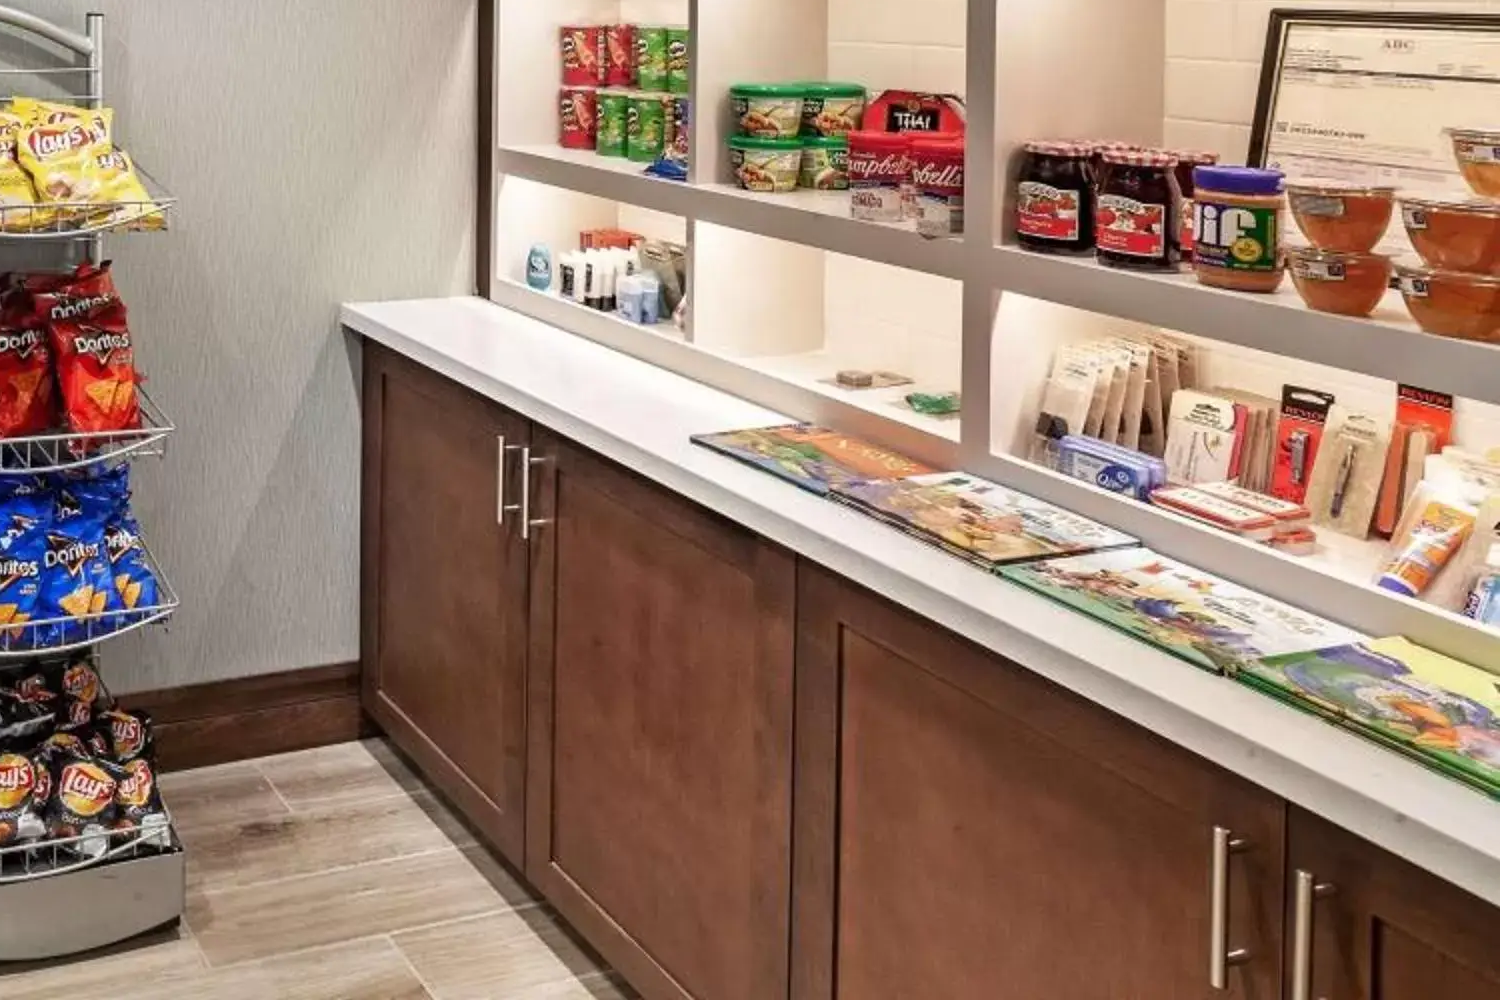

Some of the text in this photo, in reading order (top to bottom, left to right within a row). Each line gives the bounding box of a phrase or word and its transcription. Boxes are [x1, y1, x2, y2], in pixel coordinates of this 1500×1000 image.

[32, 127, 83, 158] Lay's
[75, 333, 129, 353] Doritos
[44, 542, 99, 567] Doritos
[63, 768, 114, 798] Lay's
